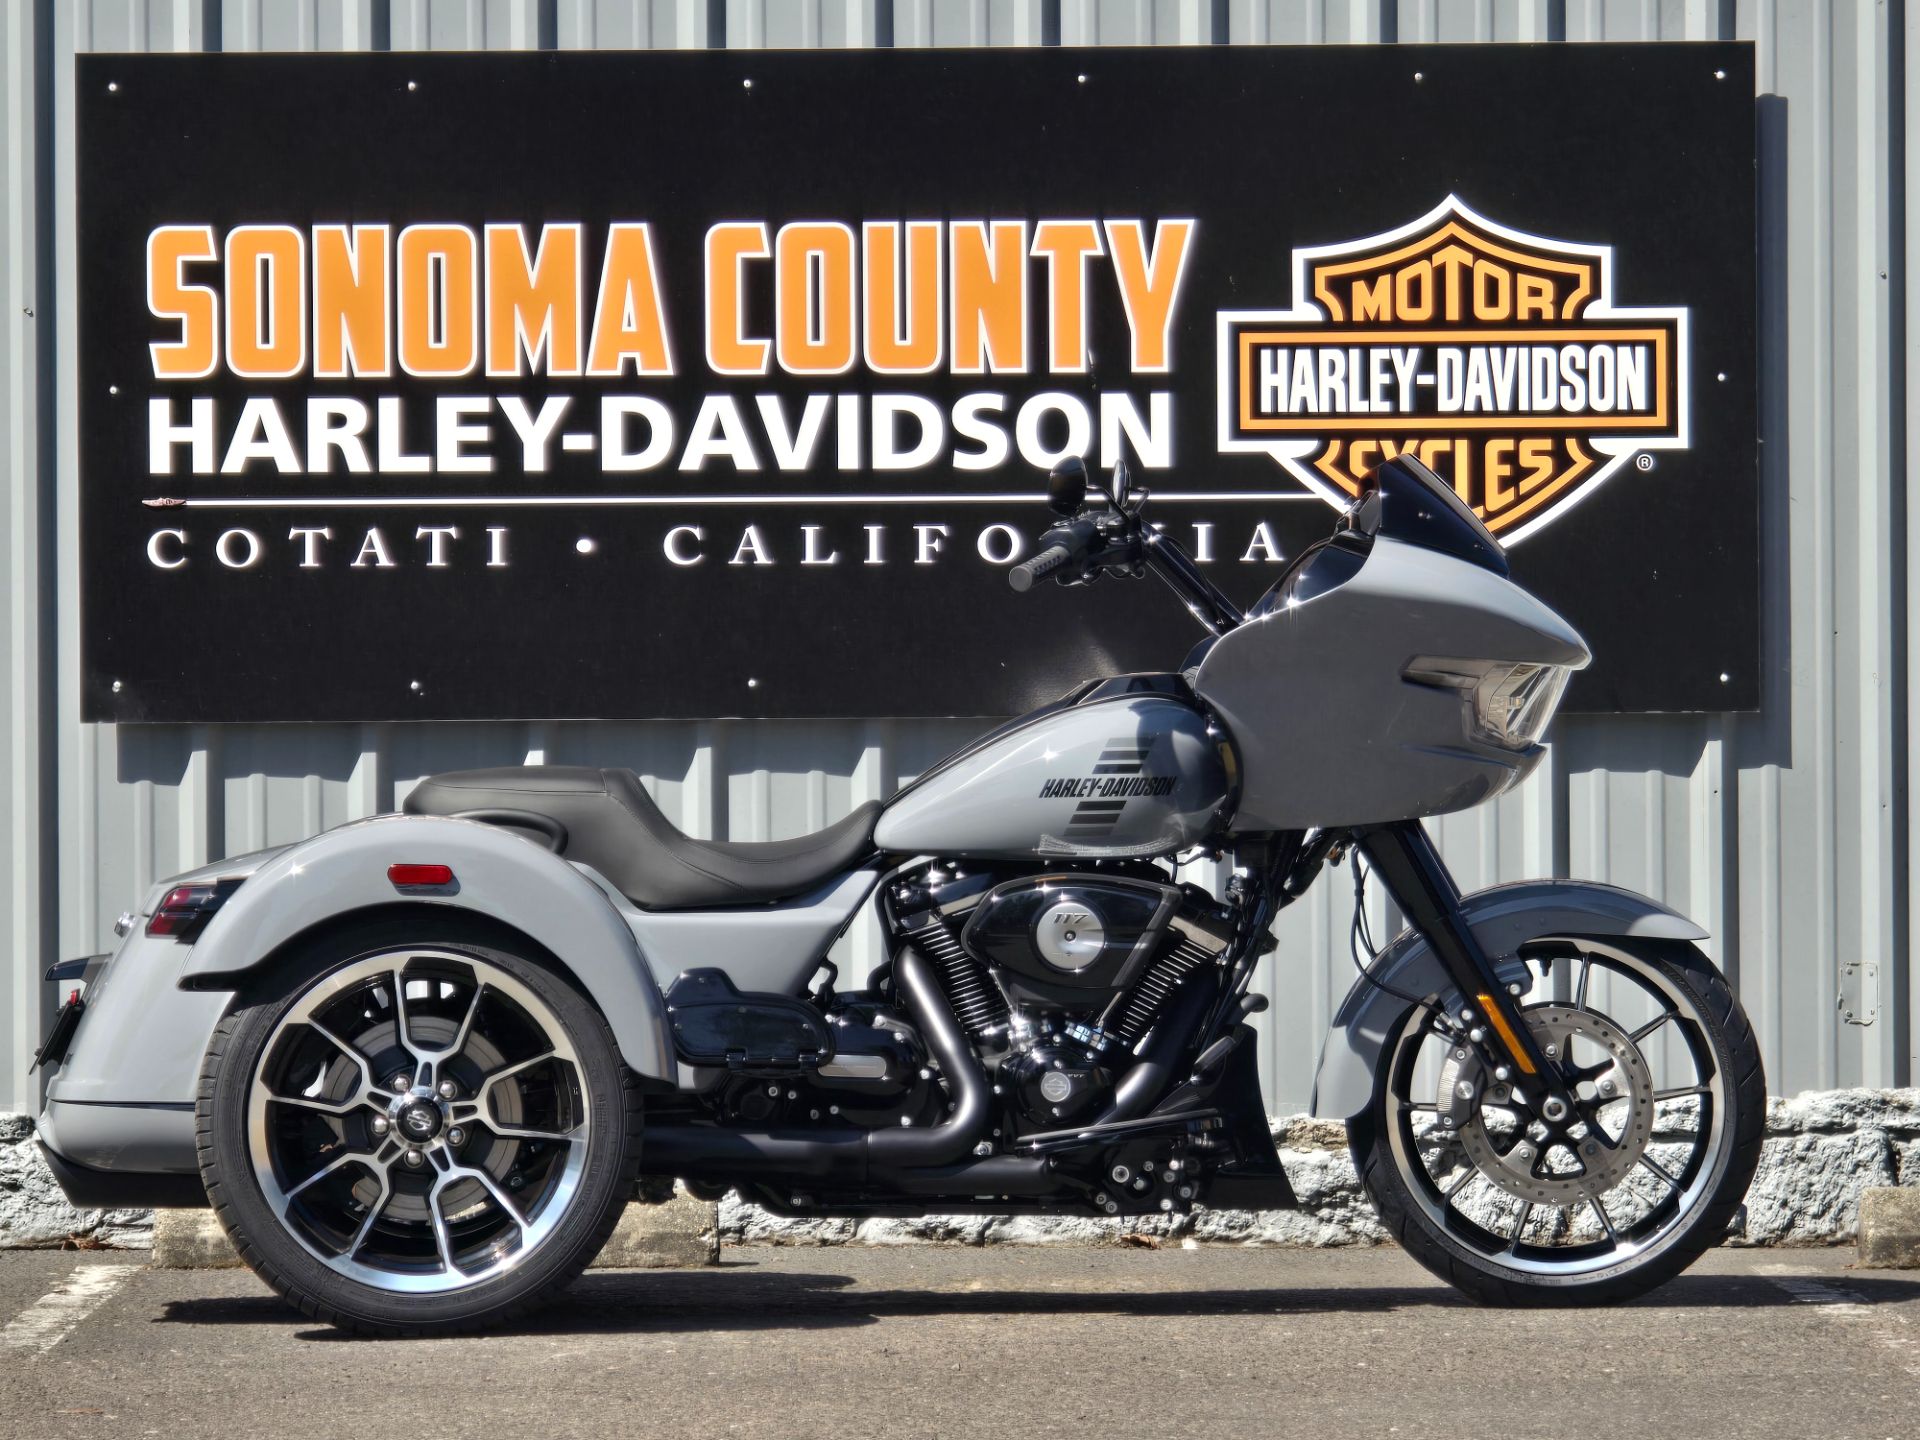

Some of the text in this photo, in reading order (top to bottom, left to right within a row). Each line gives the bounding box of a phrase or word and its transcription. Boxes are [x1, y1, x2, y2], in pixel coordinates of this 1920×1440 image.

[147, 219, 1196, 378] SONOMA COUNTY
[1351, 244, 1558, 322] MOTOR
[1260, 345, 1649, 414] HARLEY-DAVIDSON
[149, 392, 1172, 474] HARLEY-DAVIDSON
[147, 521, 1285, 569] COTATI CALIFOIA
[1038, 775, 1177, 798] HARLEY-DAVIDSON
[1053, 912, 1089, 924] 117
